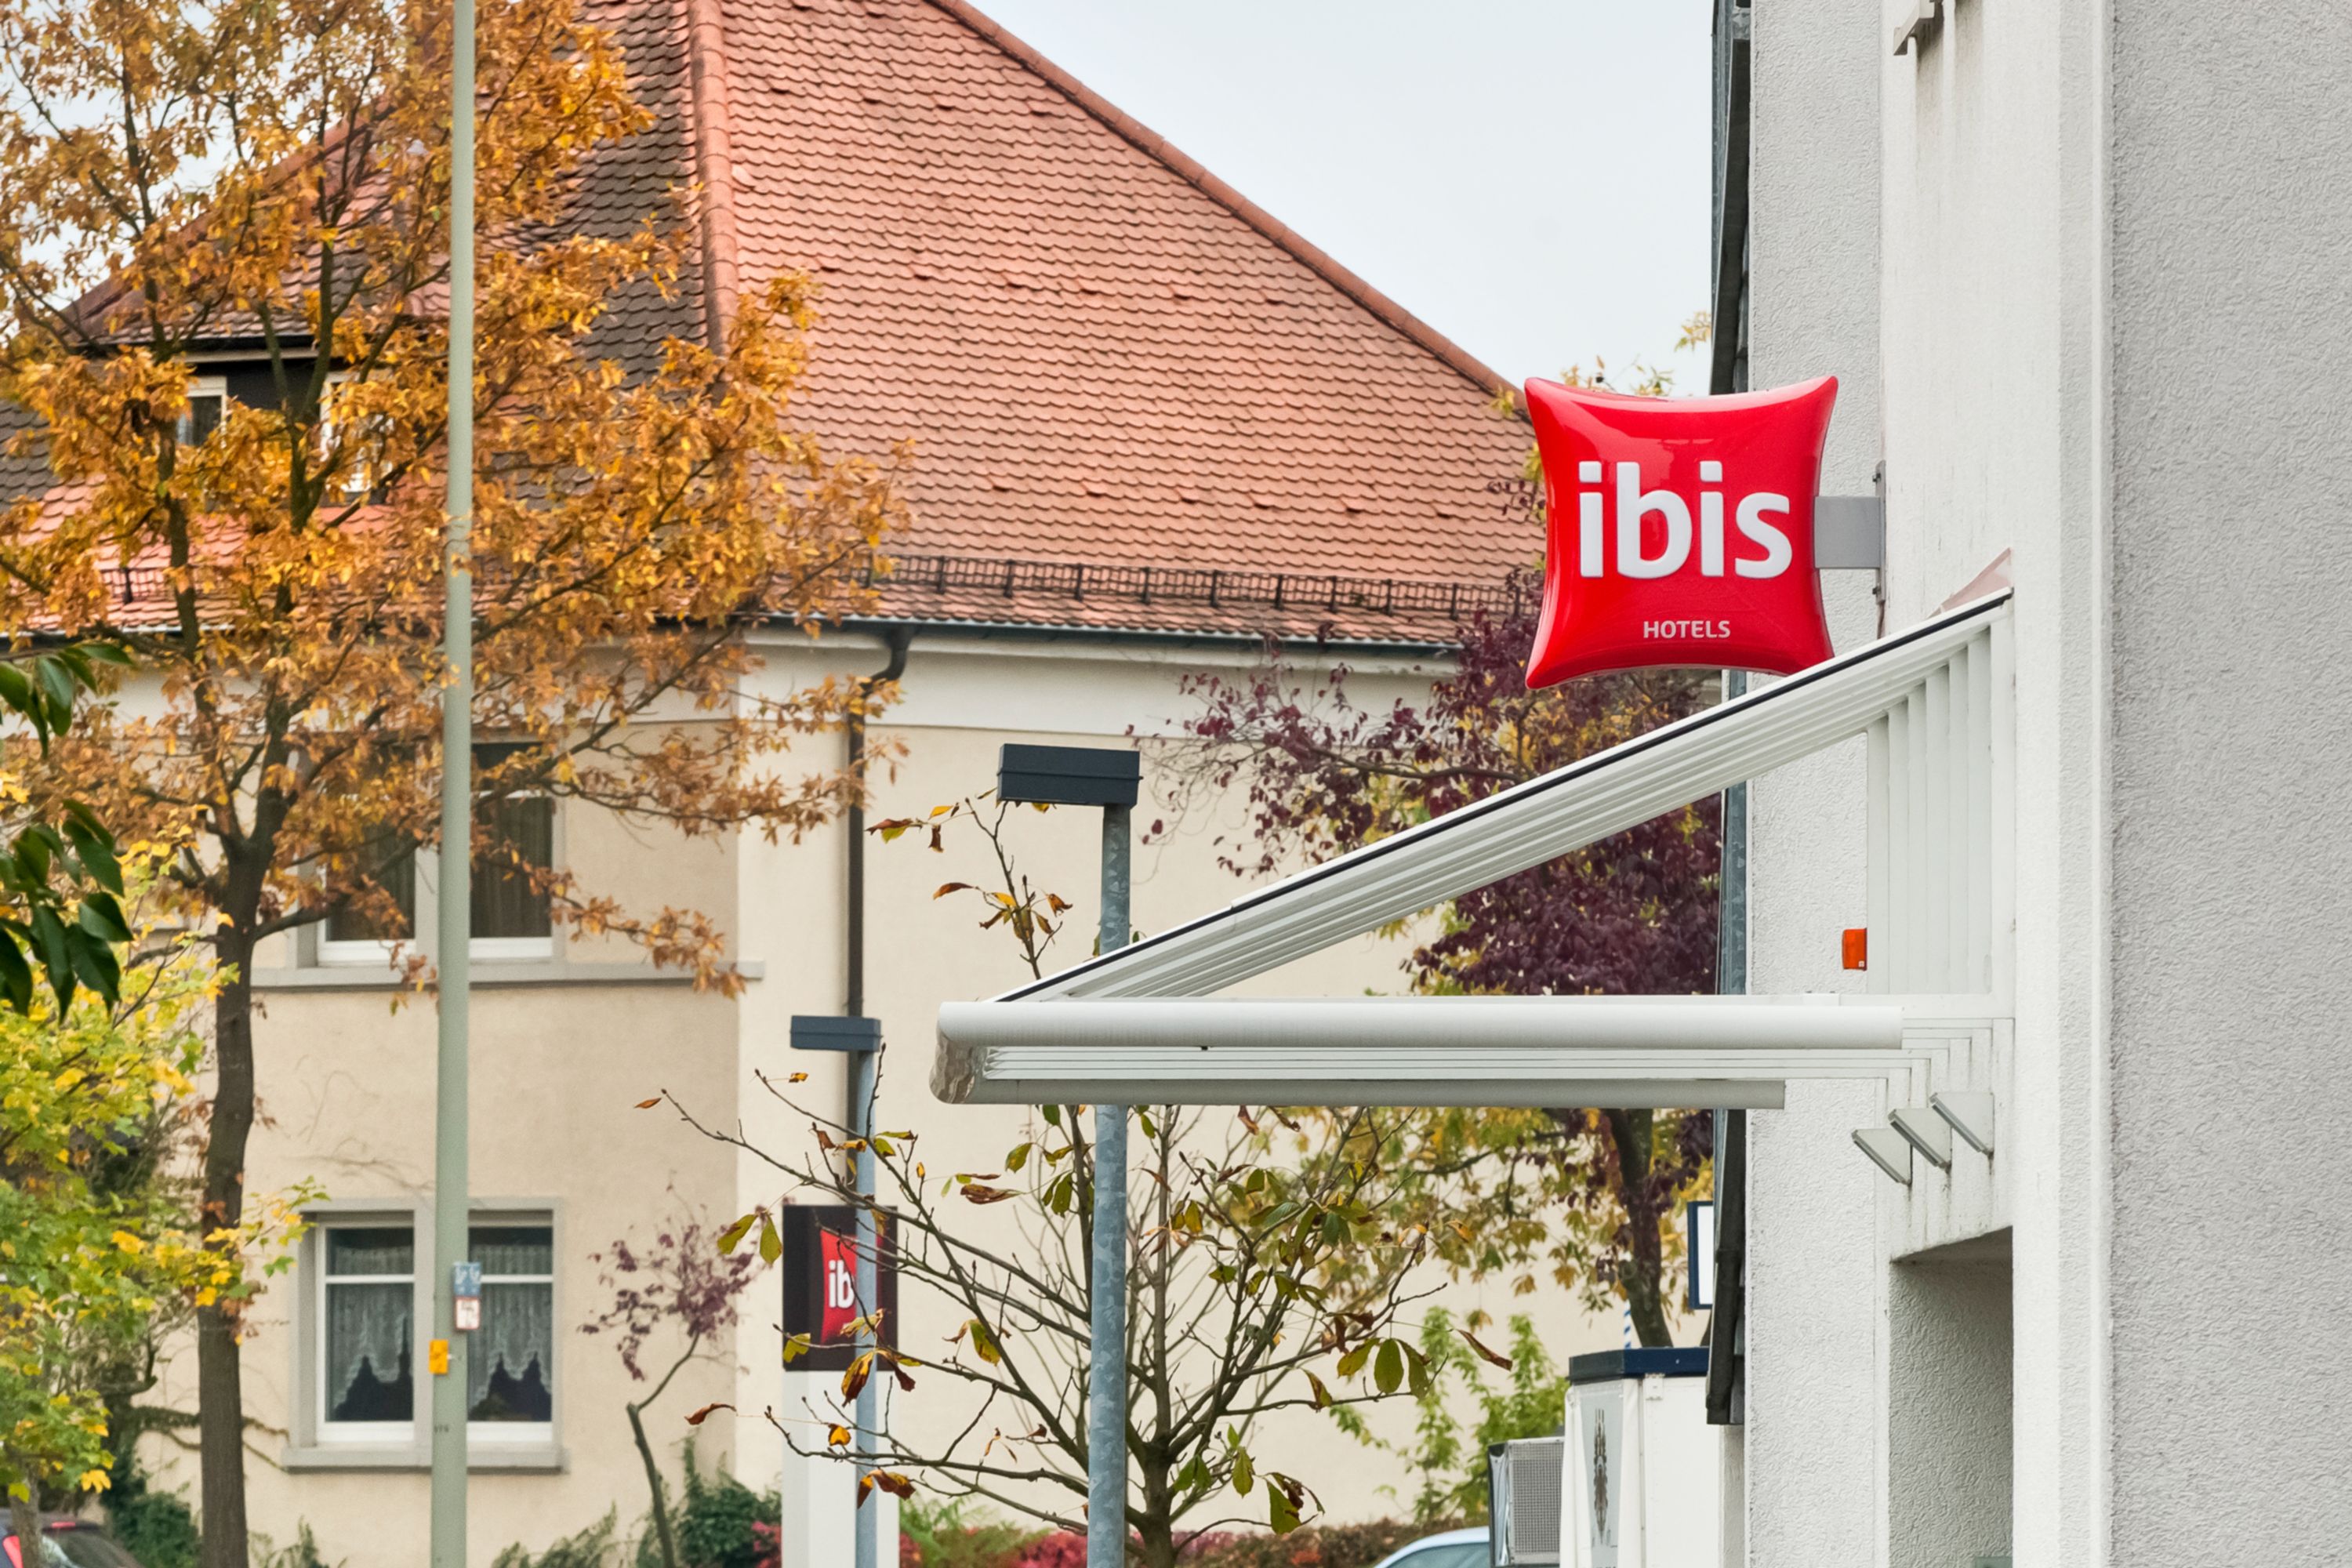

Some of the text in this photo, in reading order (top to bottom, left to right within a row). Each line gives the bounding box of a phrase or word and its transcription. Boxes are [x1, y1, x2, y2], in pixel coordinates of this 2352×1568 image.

[1578, 460, 1792, 579] ibis
[1643, 620, 1731, 639] HOTELS
[828, 1259, 855, 1308] ib
